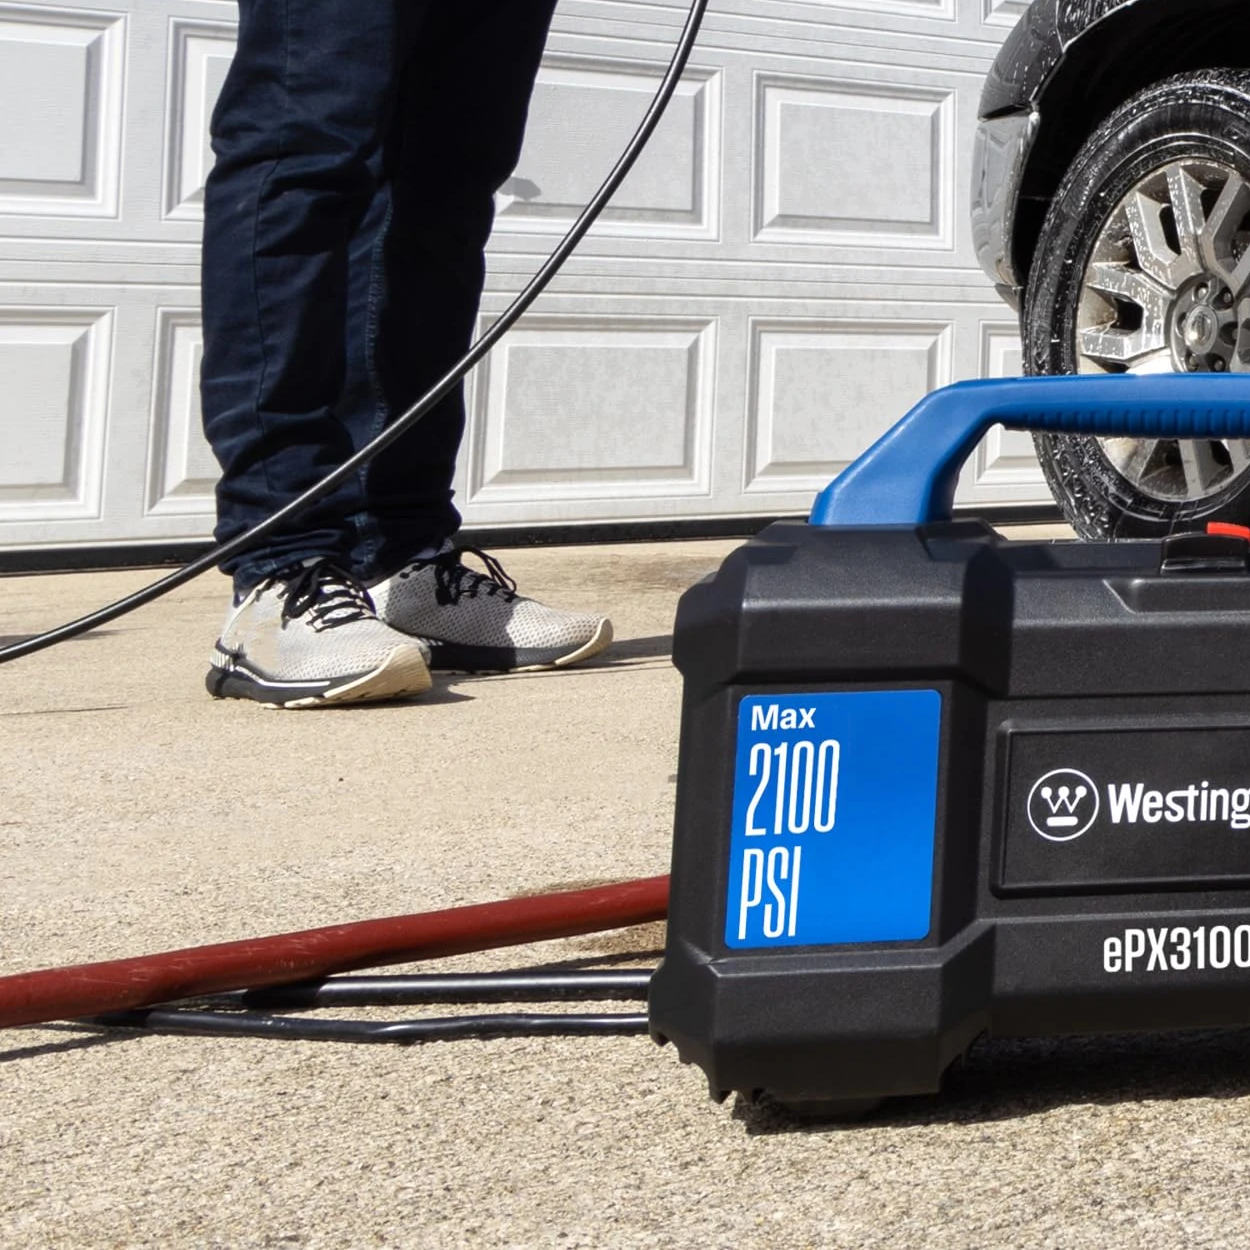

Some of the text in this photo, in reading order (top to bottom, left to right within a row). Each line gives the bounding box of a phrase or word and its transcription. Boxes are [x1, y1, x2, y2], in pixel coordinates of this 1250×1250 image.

[751, 704, 817, 732] Max
[745, 739, 841, 836] 2100
[738, 845, 802, 940] PSI
